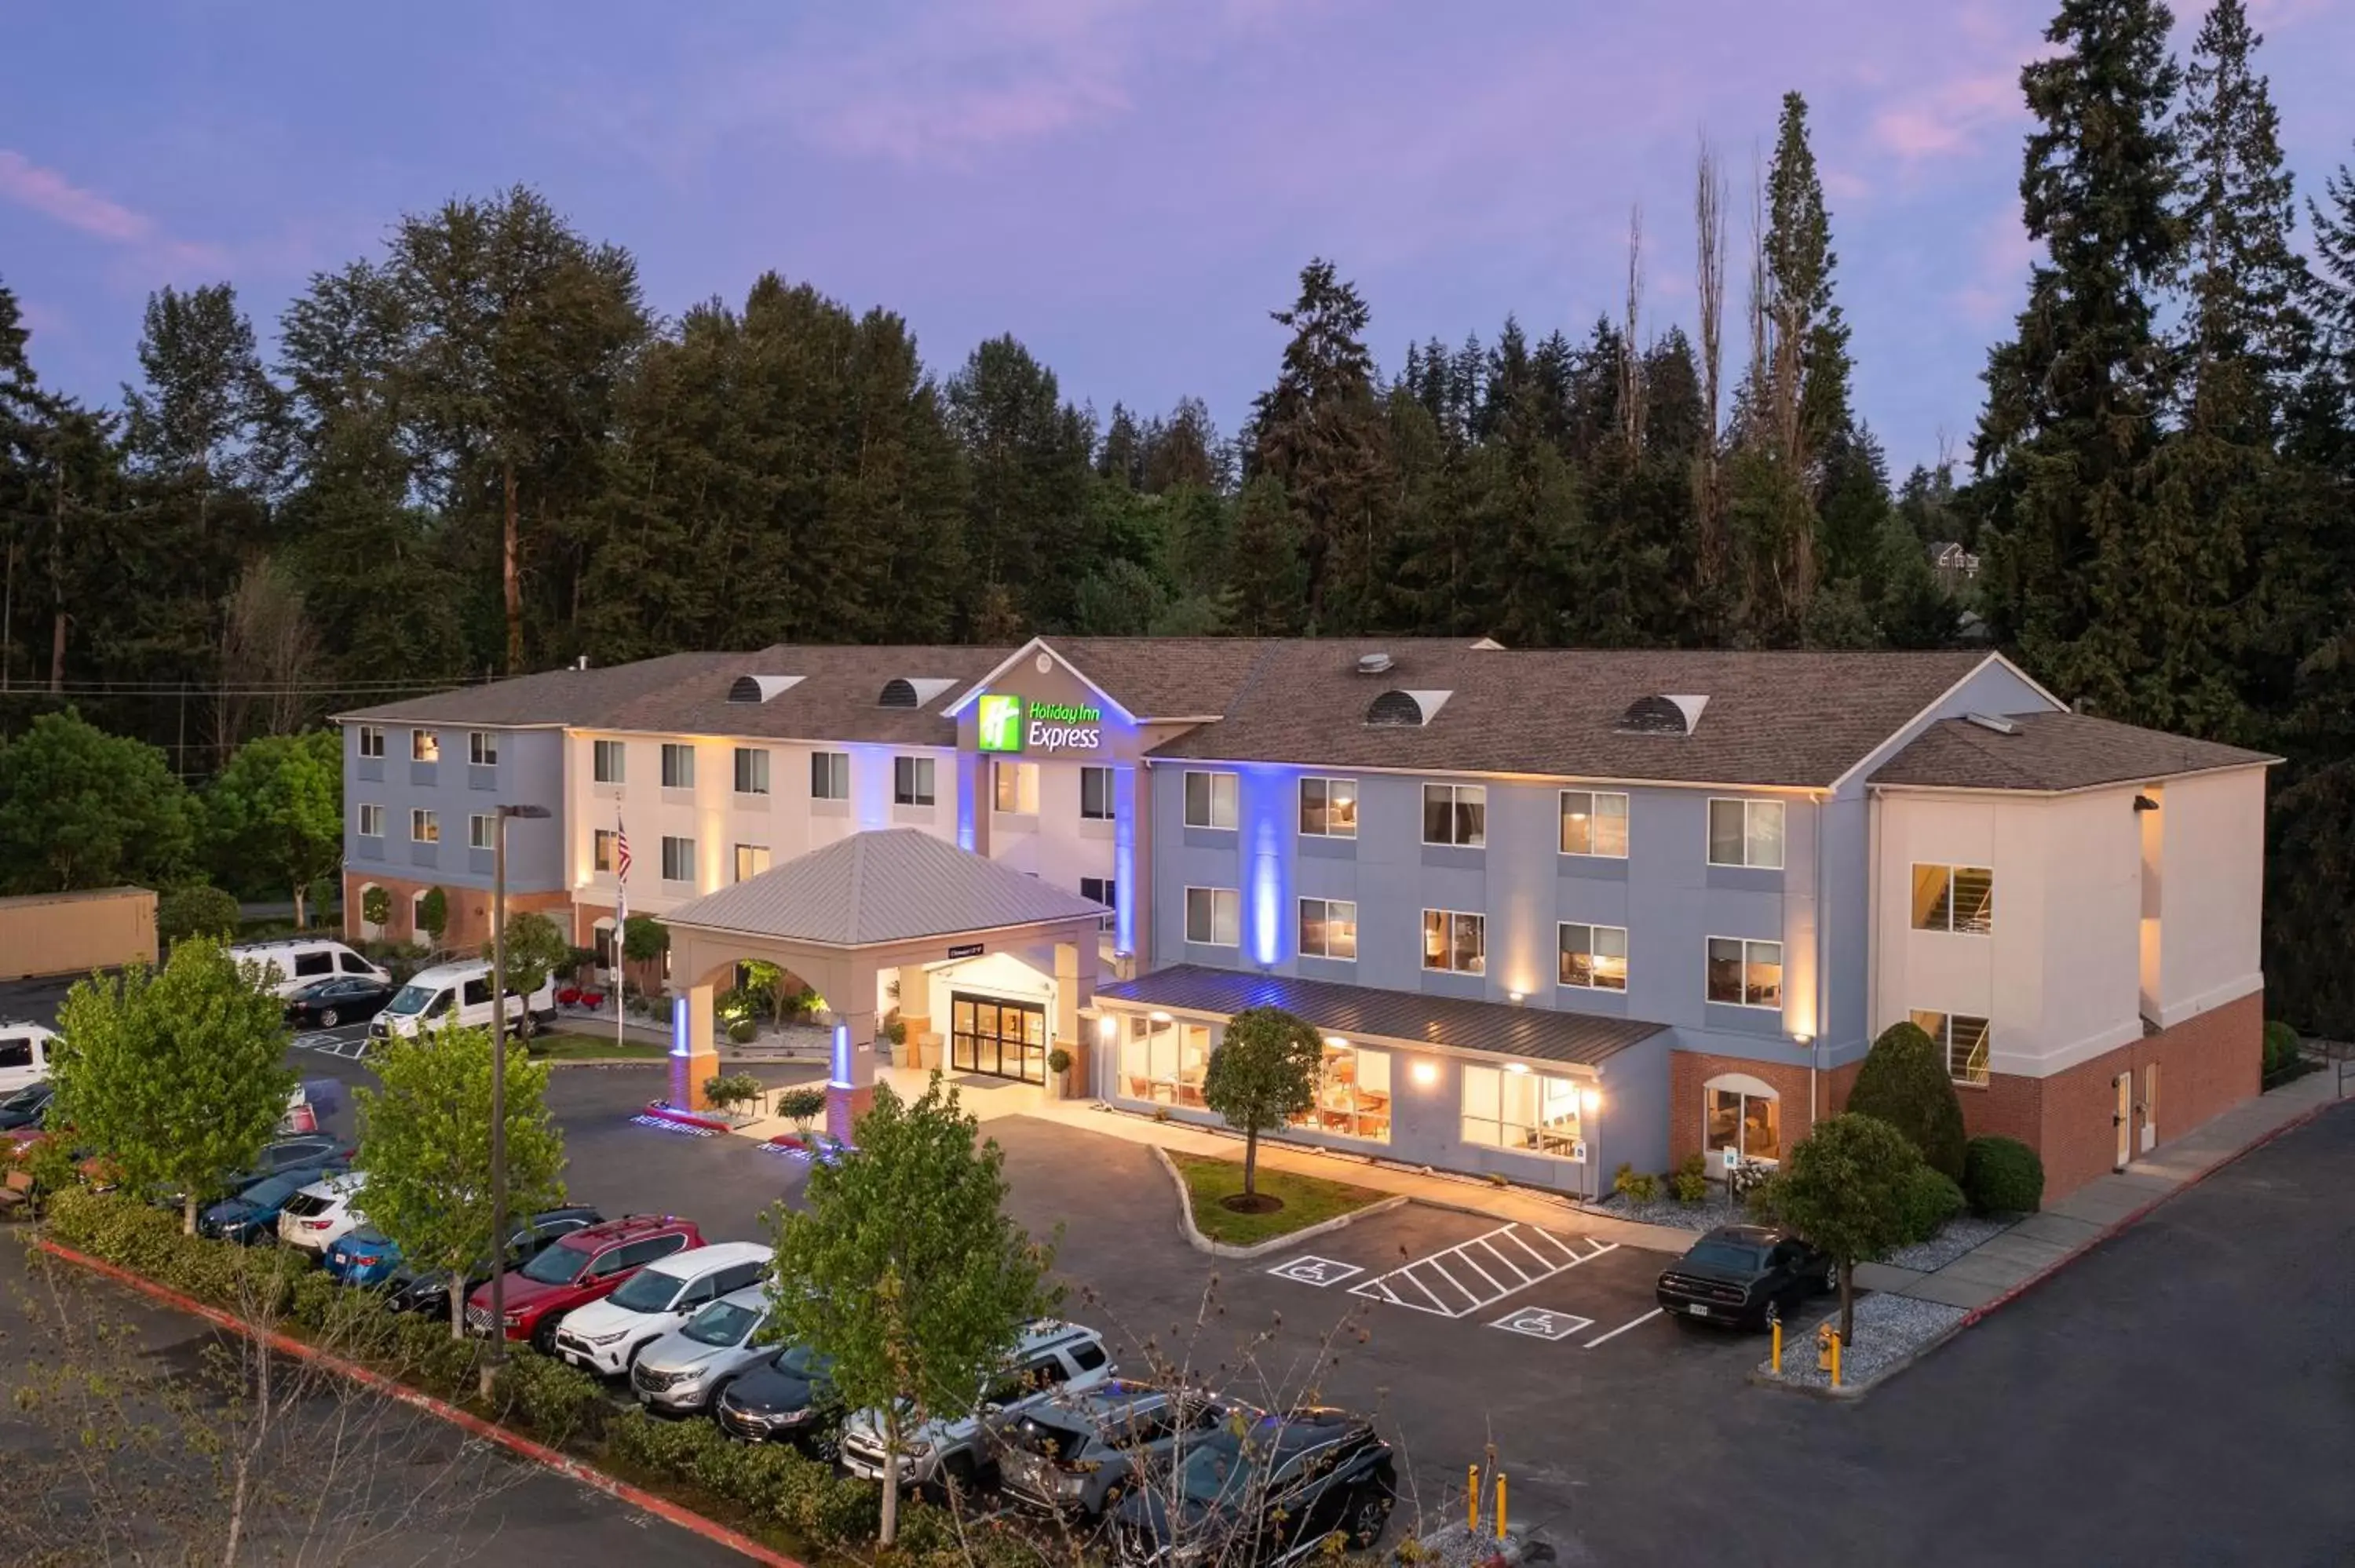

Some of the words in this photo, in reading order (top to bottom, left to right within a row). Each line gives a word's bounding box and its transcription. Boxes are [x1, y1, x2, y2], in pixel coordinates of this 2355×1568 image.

[1029, 702, 1078, 725] Holiday
[1079, 702, 1100, 721] Inn
[1029, 721, 1100, 753] Express
